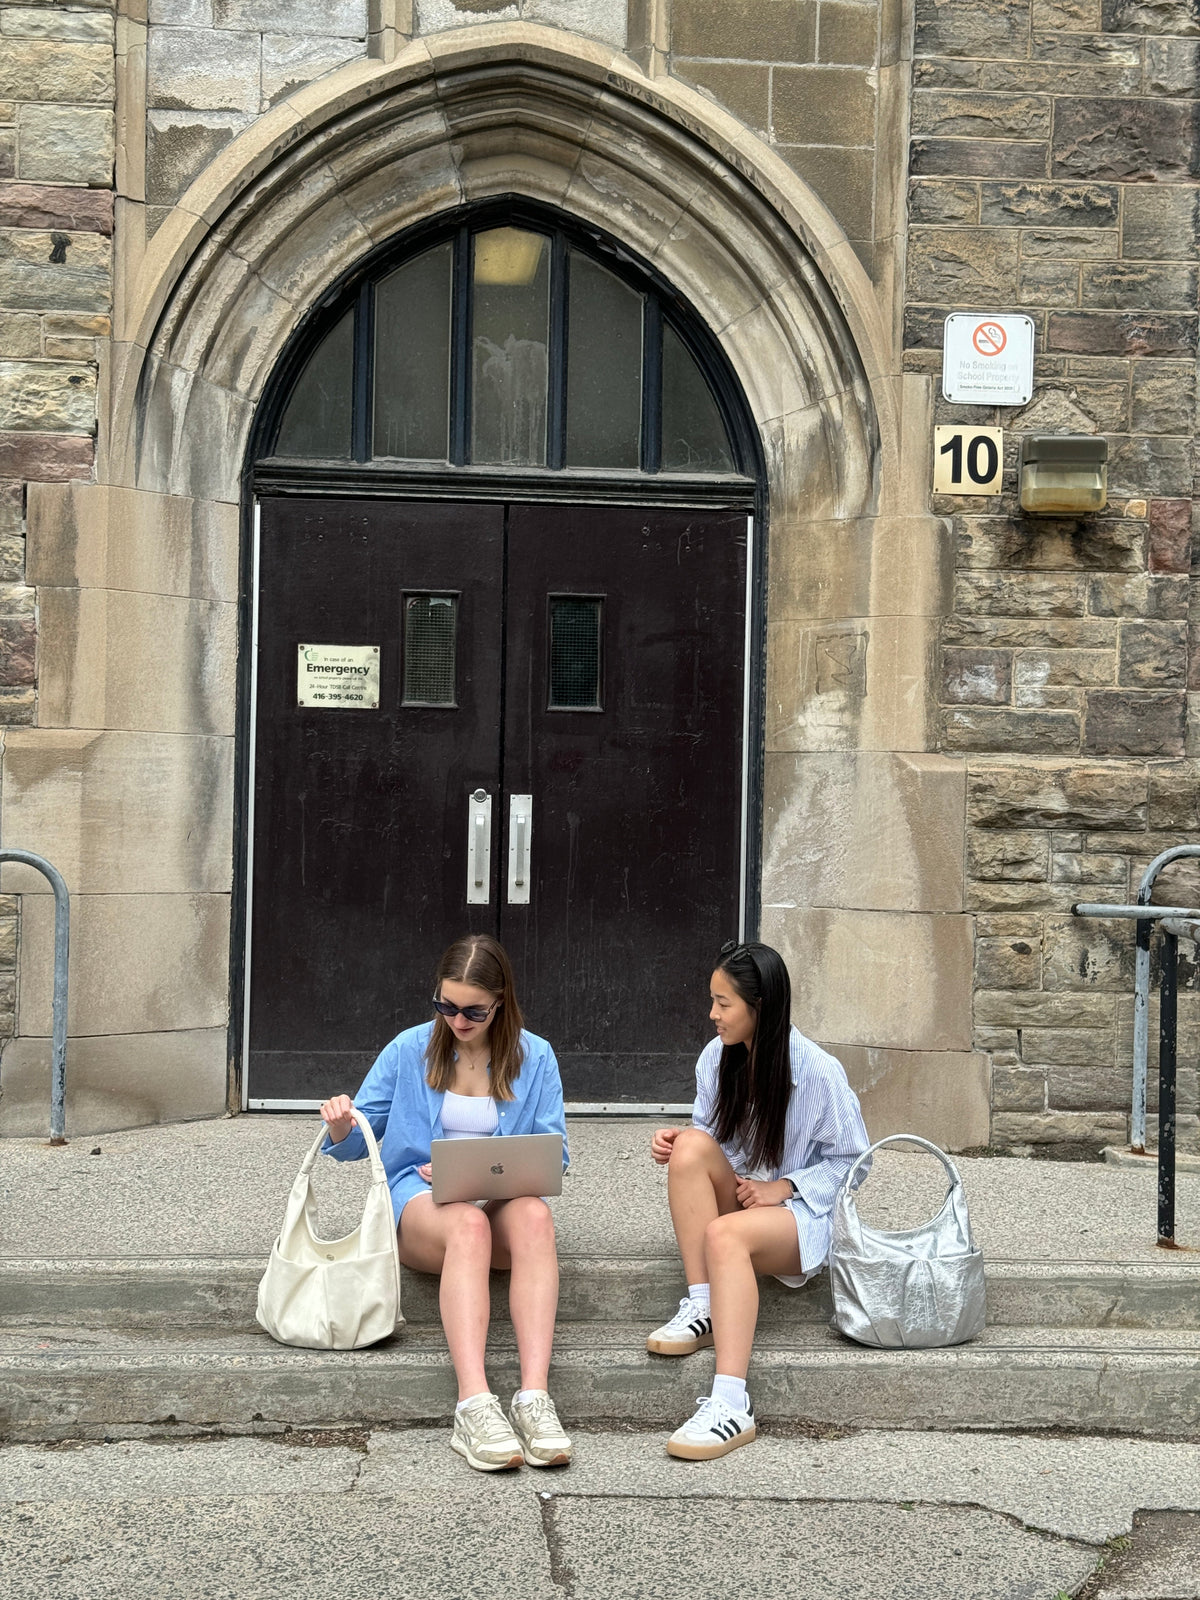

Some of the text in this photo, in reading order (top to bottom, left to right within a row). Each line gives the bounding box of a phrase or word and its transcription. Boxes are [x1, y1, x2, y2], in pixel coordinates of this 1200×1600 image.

[959, 360, 971, 369] No
[973, 360, 1007, 373] Smoking
[957, 371, 1020, 384] School Property
[940, 434, 999, 485] 10
[306, 663, 370, 676] Emergency
[312, 693, 364, 701] 416-395-4620
